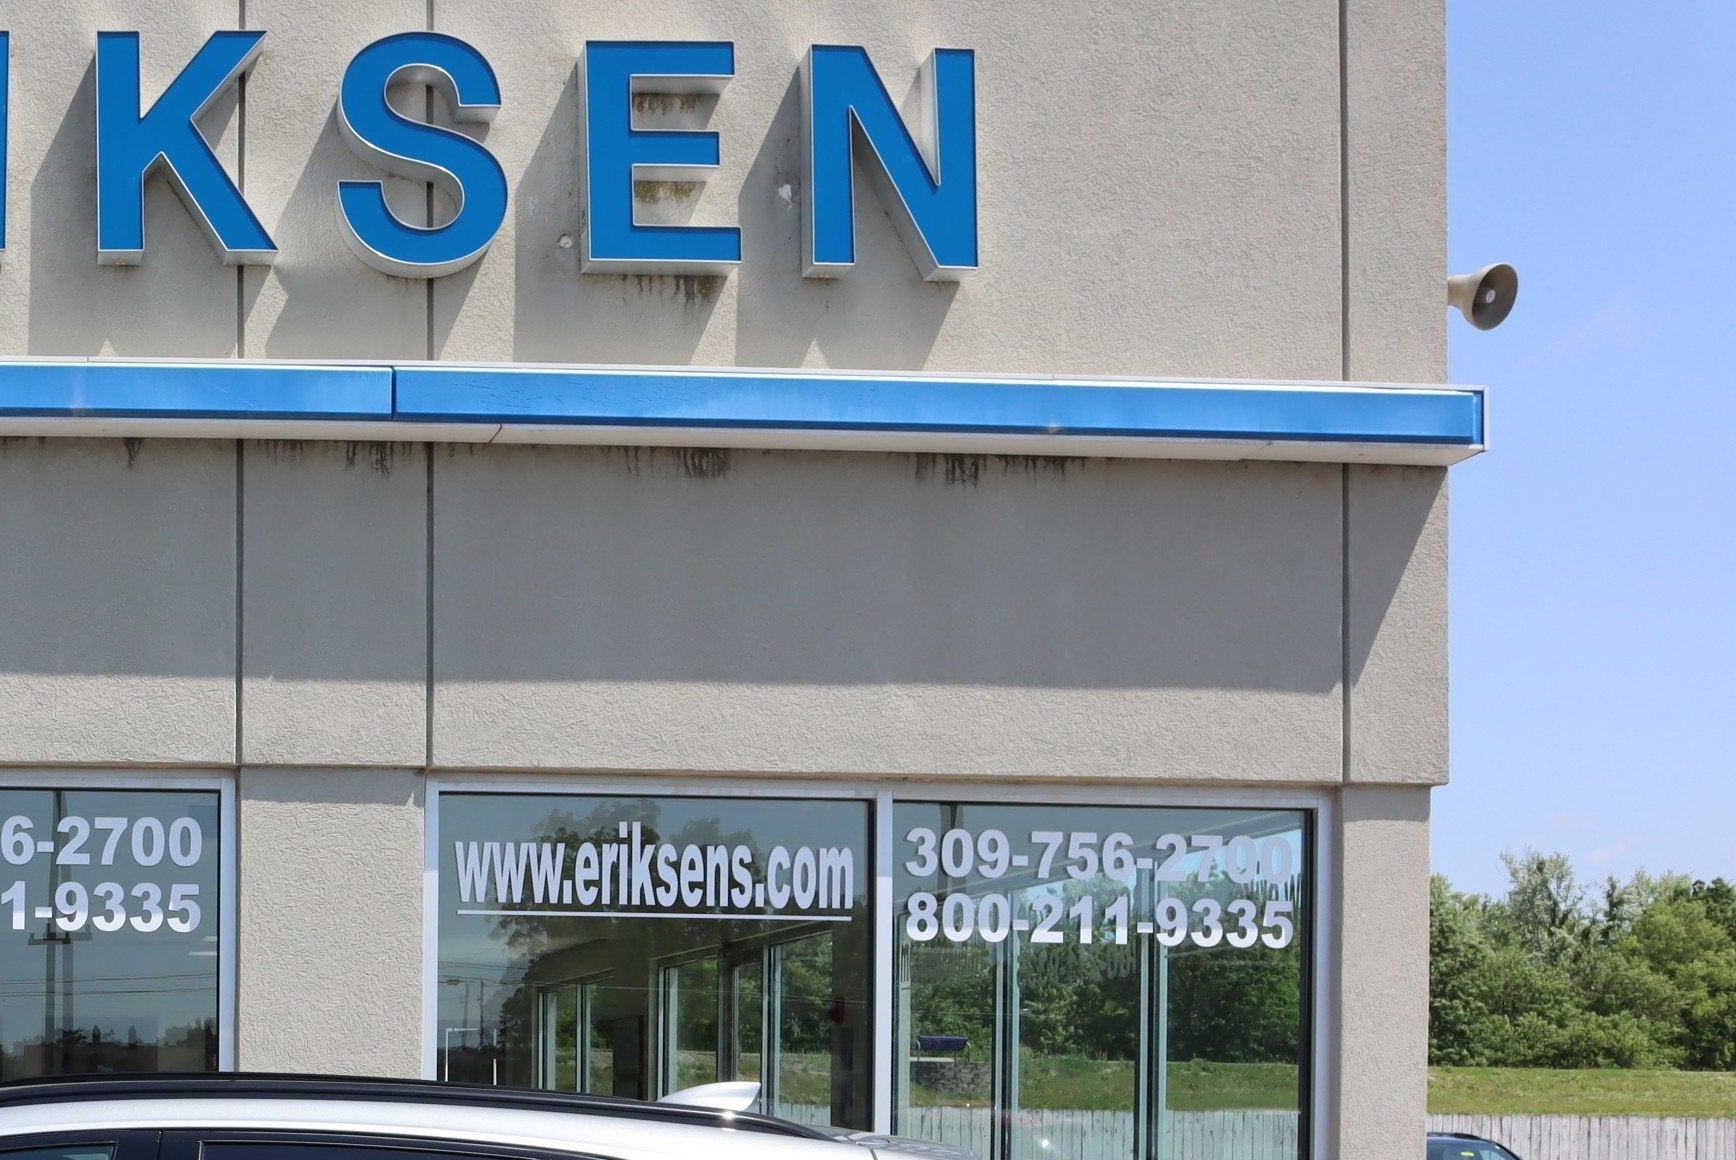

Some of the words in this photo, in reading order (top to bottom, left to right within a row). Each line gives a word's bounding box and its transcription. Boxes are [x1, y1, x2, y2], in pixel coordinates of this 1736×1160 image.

[455, 821, 854, 911] www.eriksens.com
[905, 827, 1294, 885] 309-756-2700
[905, 892, 1295, 949] 800-211-9335
